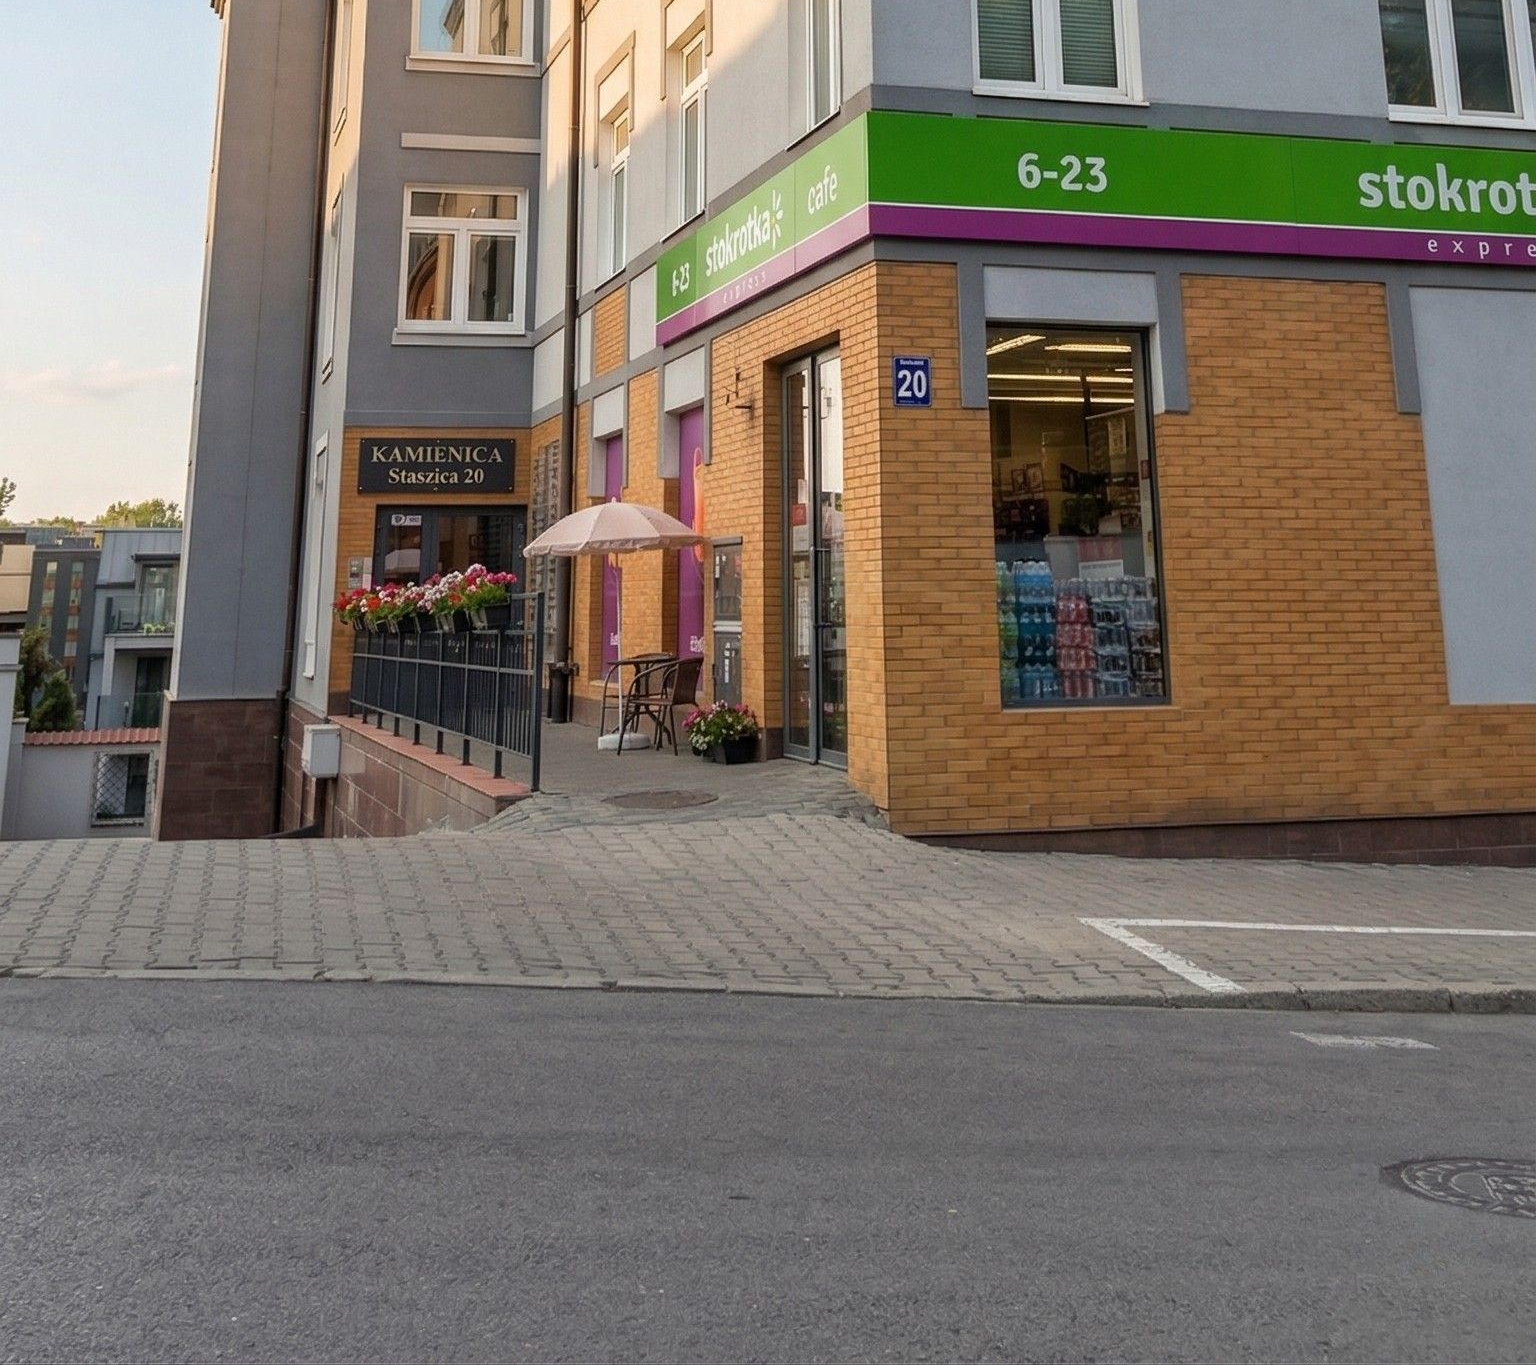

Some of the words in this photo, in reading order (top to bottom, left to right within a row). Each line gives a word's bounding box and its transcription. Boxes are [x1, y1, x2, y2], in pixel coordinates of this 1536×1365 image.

[807, 164, 838, 215] cafe
[1017, 152, 1109, 194] 6-23
[1358, 162, 1536, 216] stokrot
[705, 204, 771, 277] stokrotka
[1427, 238, 1536, 259] expre
[672, 262, 690, 297] 6-23
[897, 369, 927, 398] 20
[371, 446, 504, 463] KAMIENICA
[388, 468, 459, 485] Staszica
[463, 468, 485, 485] 20
